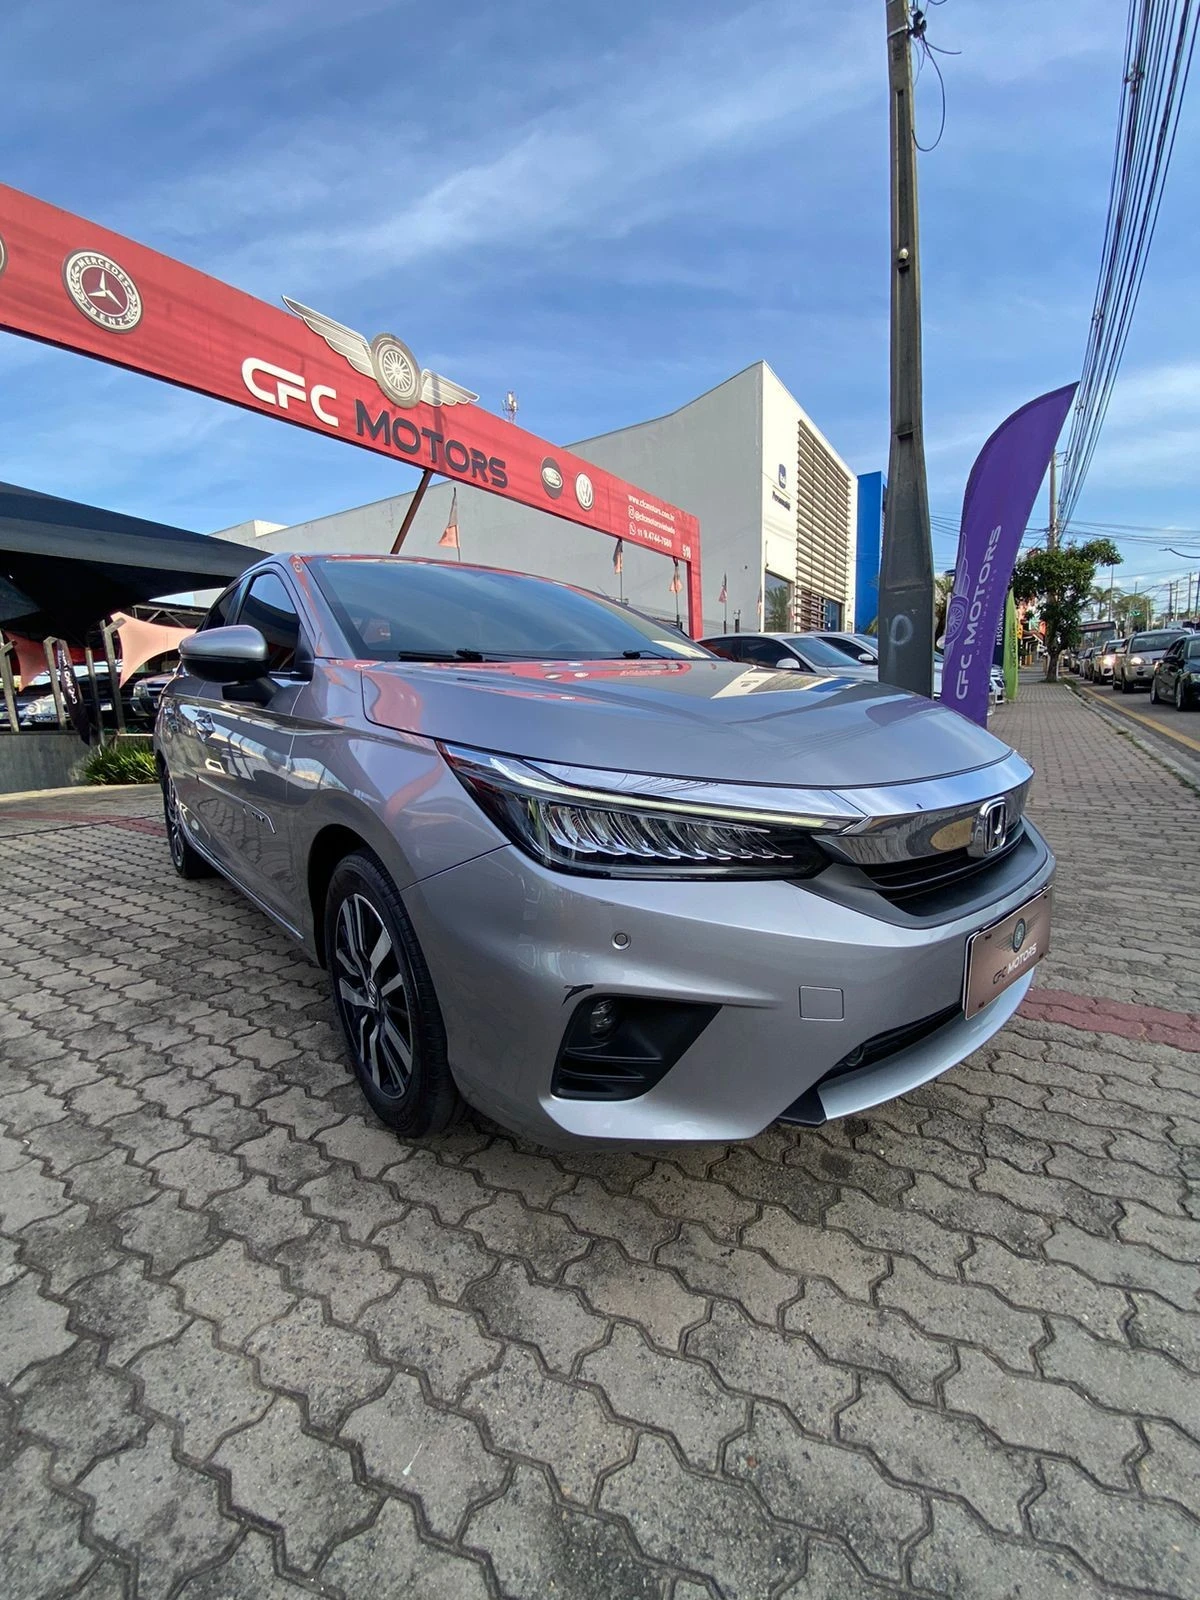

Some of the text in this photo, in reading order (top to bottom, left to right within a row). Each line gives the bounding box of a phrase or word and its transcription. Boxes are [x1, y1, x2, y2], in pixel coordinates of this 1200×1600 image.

[77, 257, 130, 287] MERCEDES
[90, 306, 125, 326] BENZ
[241, 357, 508, 489] CFC MOTORS
[956, 525, 1002, 700] CFC MOTORS
[1008, 943, 1036, 973] MOTORS
